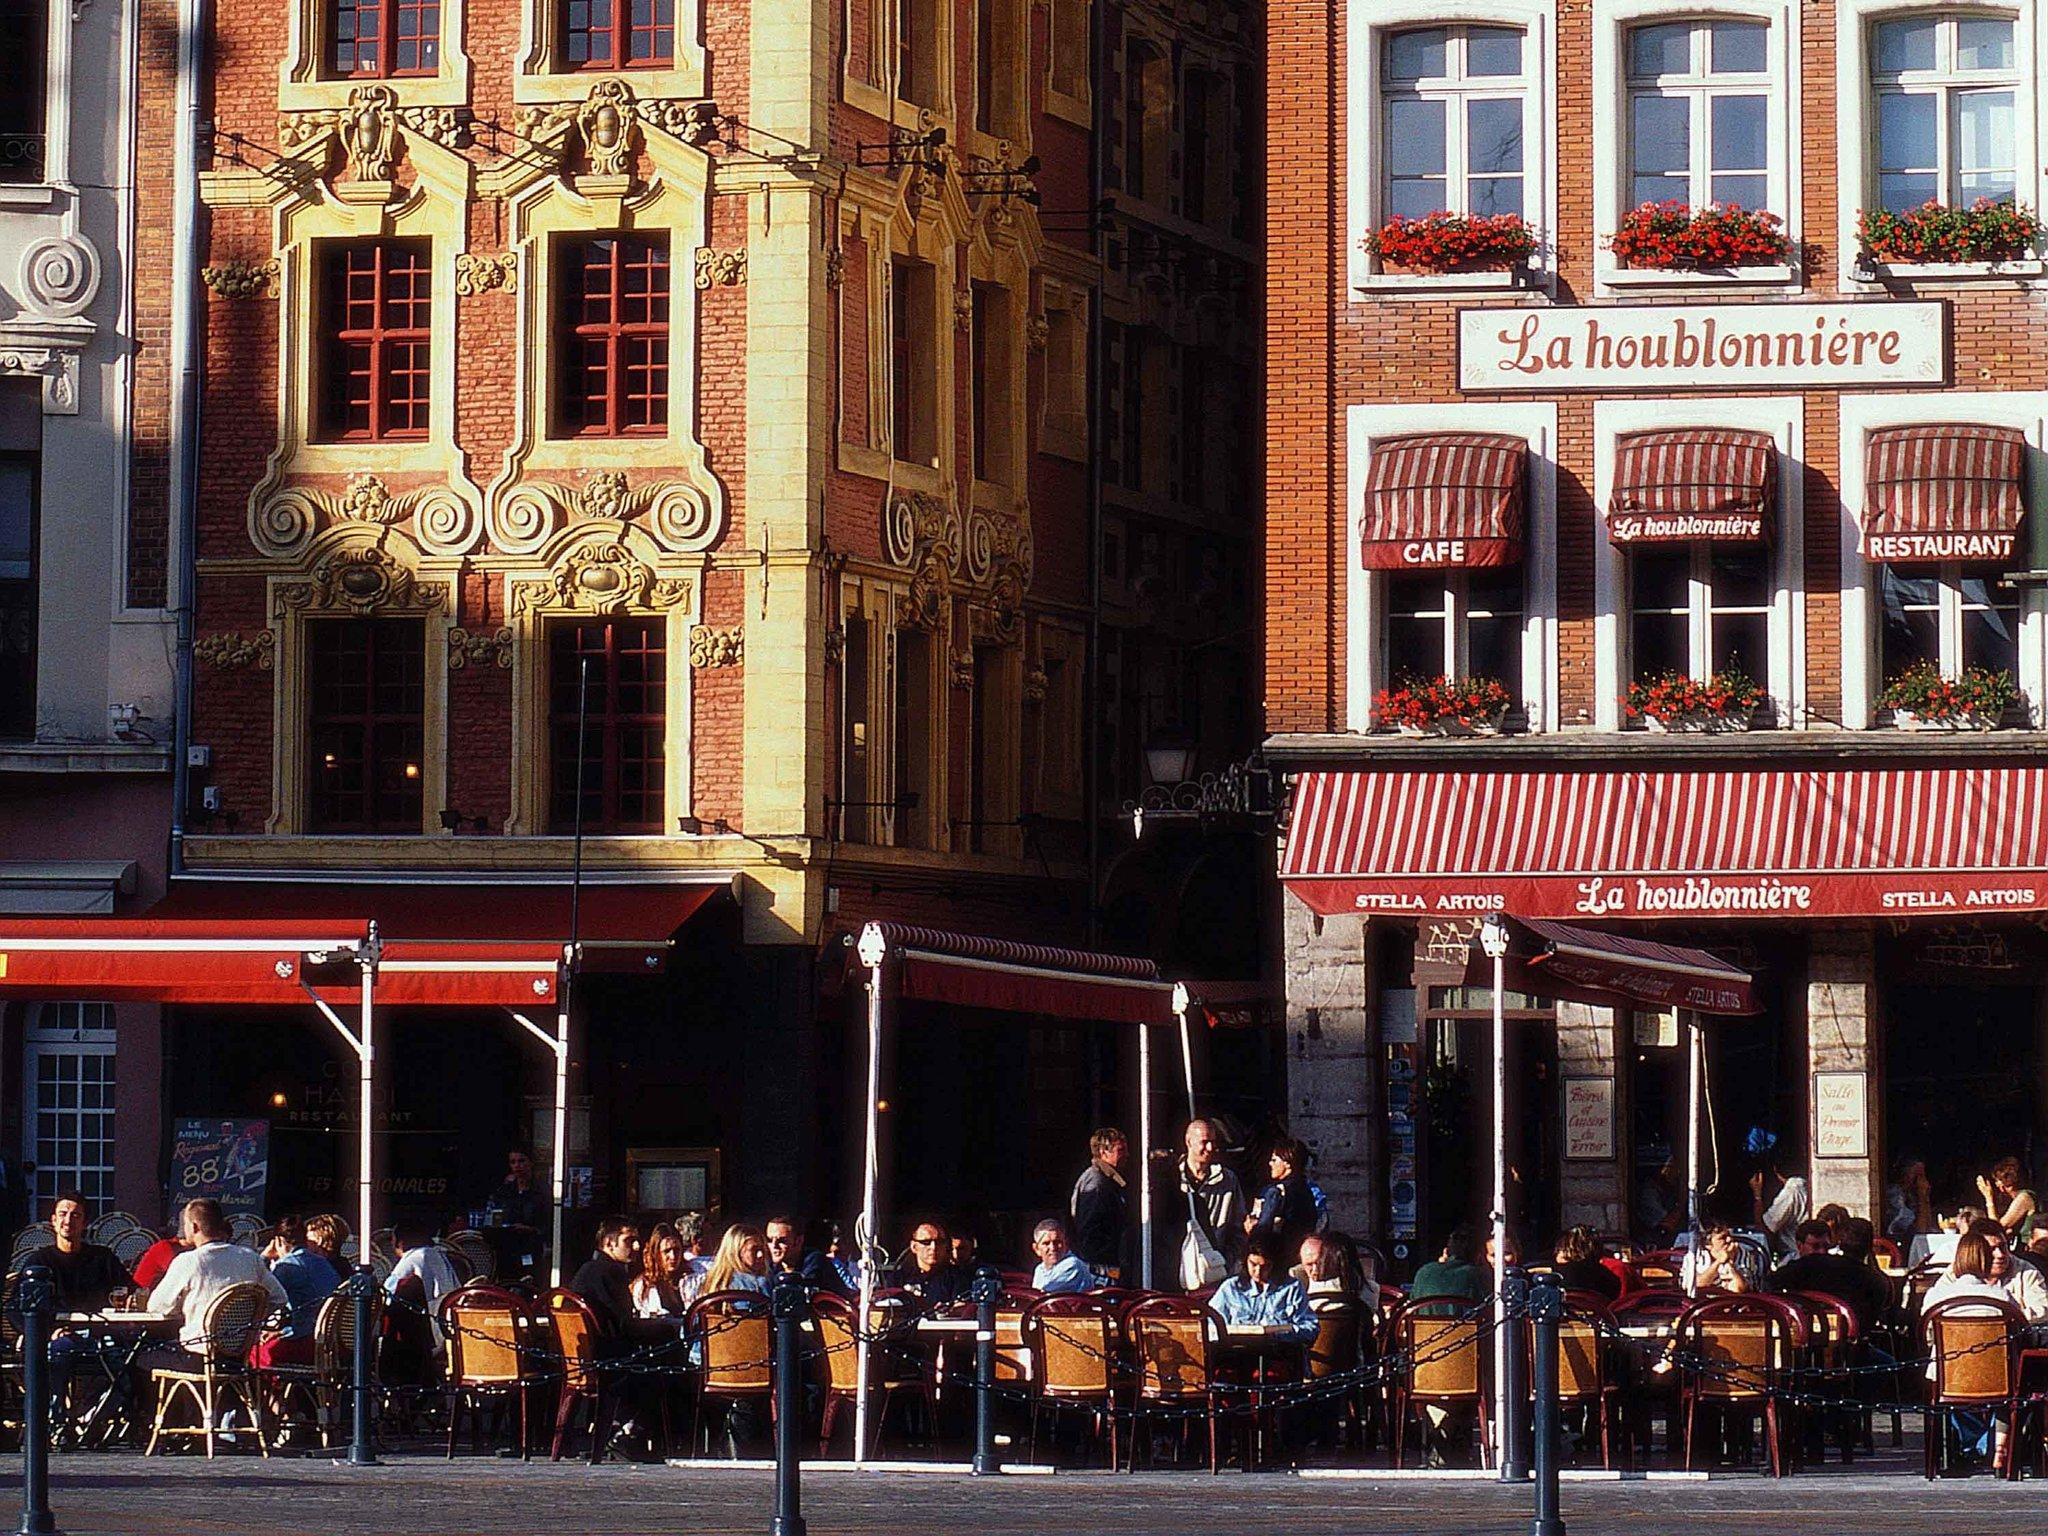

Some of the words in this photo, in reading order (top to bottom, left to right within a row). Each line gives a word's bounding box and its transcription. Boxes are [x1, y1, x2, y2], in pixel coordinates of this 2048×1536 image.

[1498, 314, 1574, 374] La
[1613, 516, 1643, 541] La
[1644, 515, 1761, 536] houblonnière
[1403, 541, 1464, 563] CAFE
[1870, 535, 2015, 558] RESTAURANT
[1355, 894, 1427, 910] STELLA
[1436, 894, 1505, 910] ARTOIS
[1575, 876, 1625, 915] La
[1636, 878, 1811, 911] houblonnière
[1882, 891, 1957, 908] STELLA
[1965, 889, 2036, 906] ARTOIS
[178, 1130, 210, 1140] MENU
